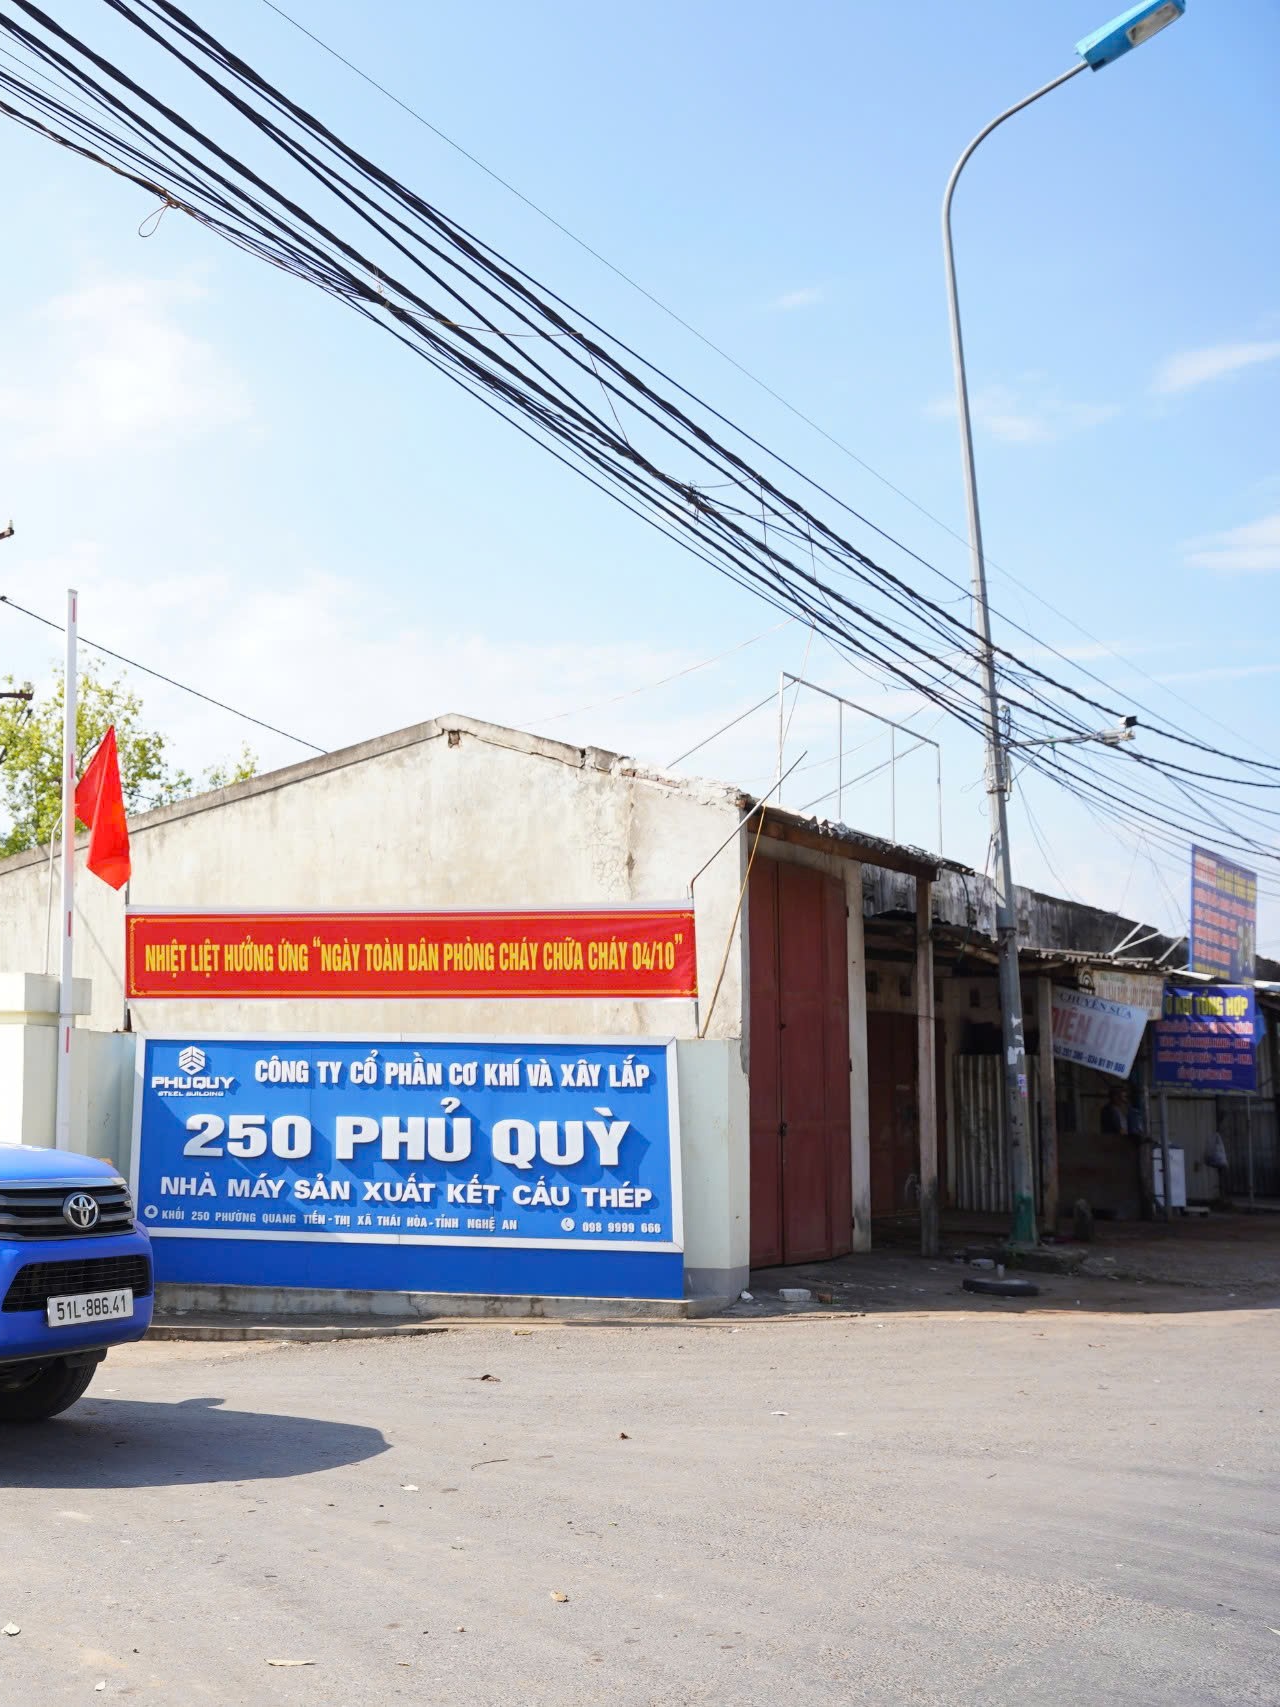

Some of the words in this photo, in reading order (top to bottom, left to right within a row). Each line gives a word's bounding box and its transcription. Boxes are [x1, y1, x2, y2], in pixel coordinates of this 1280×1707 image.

[146, 940, 187, 978] NHIỆT
[191, 939, 220, 978] LIỆT
[224, 936, 274, 972] HƯỞNG
[278, 938, 308, 972] ỨNG
[364, 937, 404, 972] TOÀN
[408, 938, 439, 971] DÂN
[444, 936, 495, 971] PHÒNG
[499, 938, 538, 971] CHÁY
[542, 937, 584, 970] CHỮA
[588, 936, 628, 970] CHÁY
[1224, 994, 1249, 1020] HỢP
[255, 1055, 310, 1084] CÔNG
[316, 1061, 342, 1084] TY
[350, 1050, 379, 1084] CỔ
[385, 1052, 442, 1086] PHẦN
[448, 1061, 478, 1086] CƠ
[484, 1058, 522, 1086] KHÍ
[527, 1058, 554, 1087] VÀ
[560, 1059, 602, 1087] XÂY
[609, 1054, 650, 1088] LẮP
[184, 1114, 312, 1160] 250
[335, 1096, 472, 1162] PHỦ
[492, 1106, 631, 1170] QUỲ
[160, 1172, 217, 1198] NHÀ
[227, 1172, 286, 1198] MÁY
[294, 1172, 350, 1201] SẢN
[362, 1172, 436, 1203] XUẤT
[447, 1174, 500, 1205] KẾT
[512, 1176, 570, 1207] CẤU
[580, 1180, 652, 1208] THÉP
[162, 1206, 185, 1220] KHỐI
[191, 1211, 210, 1222] 250
[214, 1209, 256, 1223] PHƯỜNG
[262, 1214, 296, 1224] QUANG
[357, 1212, 372, 1226] XÃ
[377, 1212, 401, 1227] THÁI
[468, 1216, 496, 1232] NGHỆ
[502, 1220, 518, 1230] AN
[582, 1222, 602, 1233] 098
[607, 1222, 635, 1234] 9999
[640, 1222, 662, 1234] 666
[56, 1294, 126, 1320] 51L-886.41
